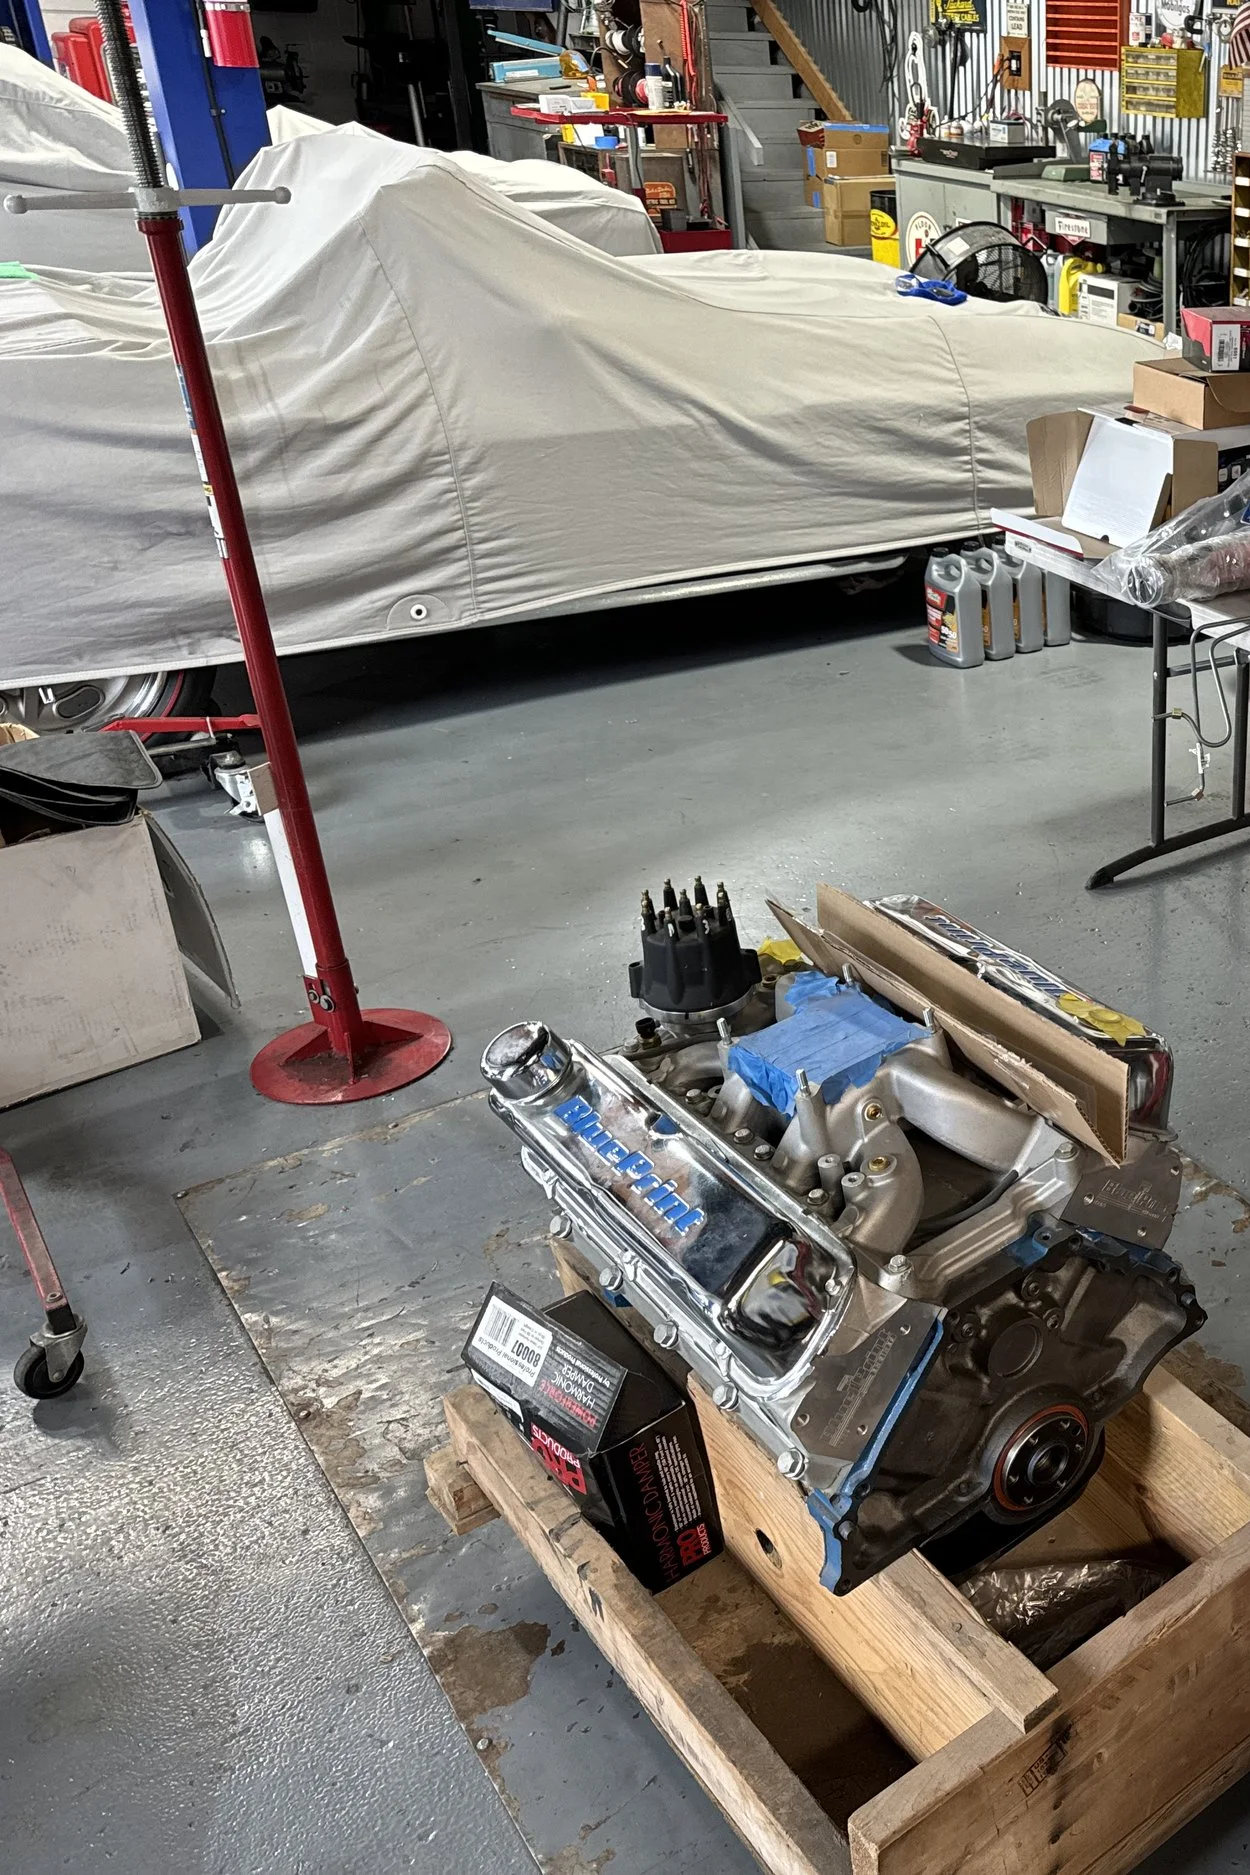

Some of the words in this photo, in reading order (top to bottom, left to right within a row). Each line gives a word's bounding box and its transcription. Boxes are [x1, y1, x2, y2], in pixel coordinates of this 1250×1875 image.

[1011, 23, 1023, 31] LEAD
[1057, 219, 1089, 235] Firestone
[553, 1094, 705, 1237] BluePrint
[478, 1336, 502, 1358] Products
[511, 1339, 542, 1368] 80007
[556, 1346, 576, 1365] Products
[502, 1351, 535, 1378] Professional
[561, 1362, 595, 1393] DAMPER
[576, 1359, 603, 1383] Professional
[551, 1371, 596, 1410] HARMONIC
[601, 1377, 611, 1388] by
[540, 1380, 598, 1429] POWERFORCE
[531, 1424, 581, 1469] PRODUCTS
[532, 1437, 587, 1495] PRO
[629, 1442, 659, 1504] DAMPER
[645, 1501, 681, 1582] HARMONIC
[676, 1528, 706, 1568] PRO
[696, 1522, 712, 1556] PRODUCTS
